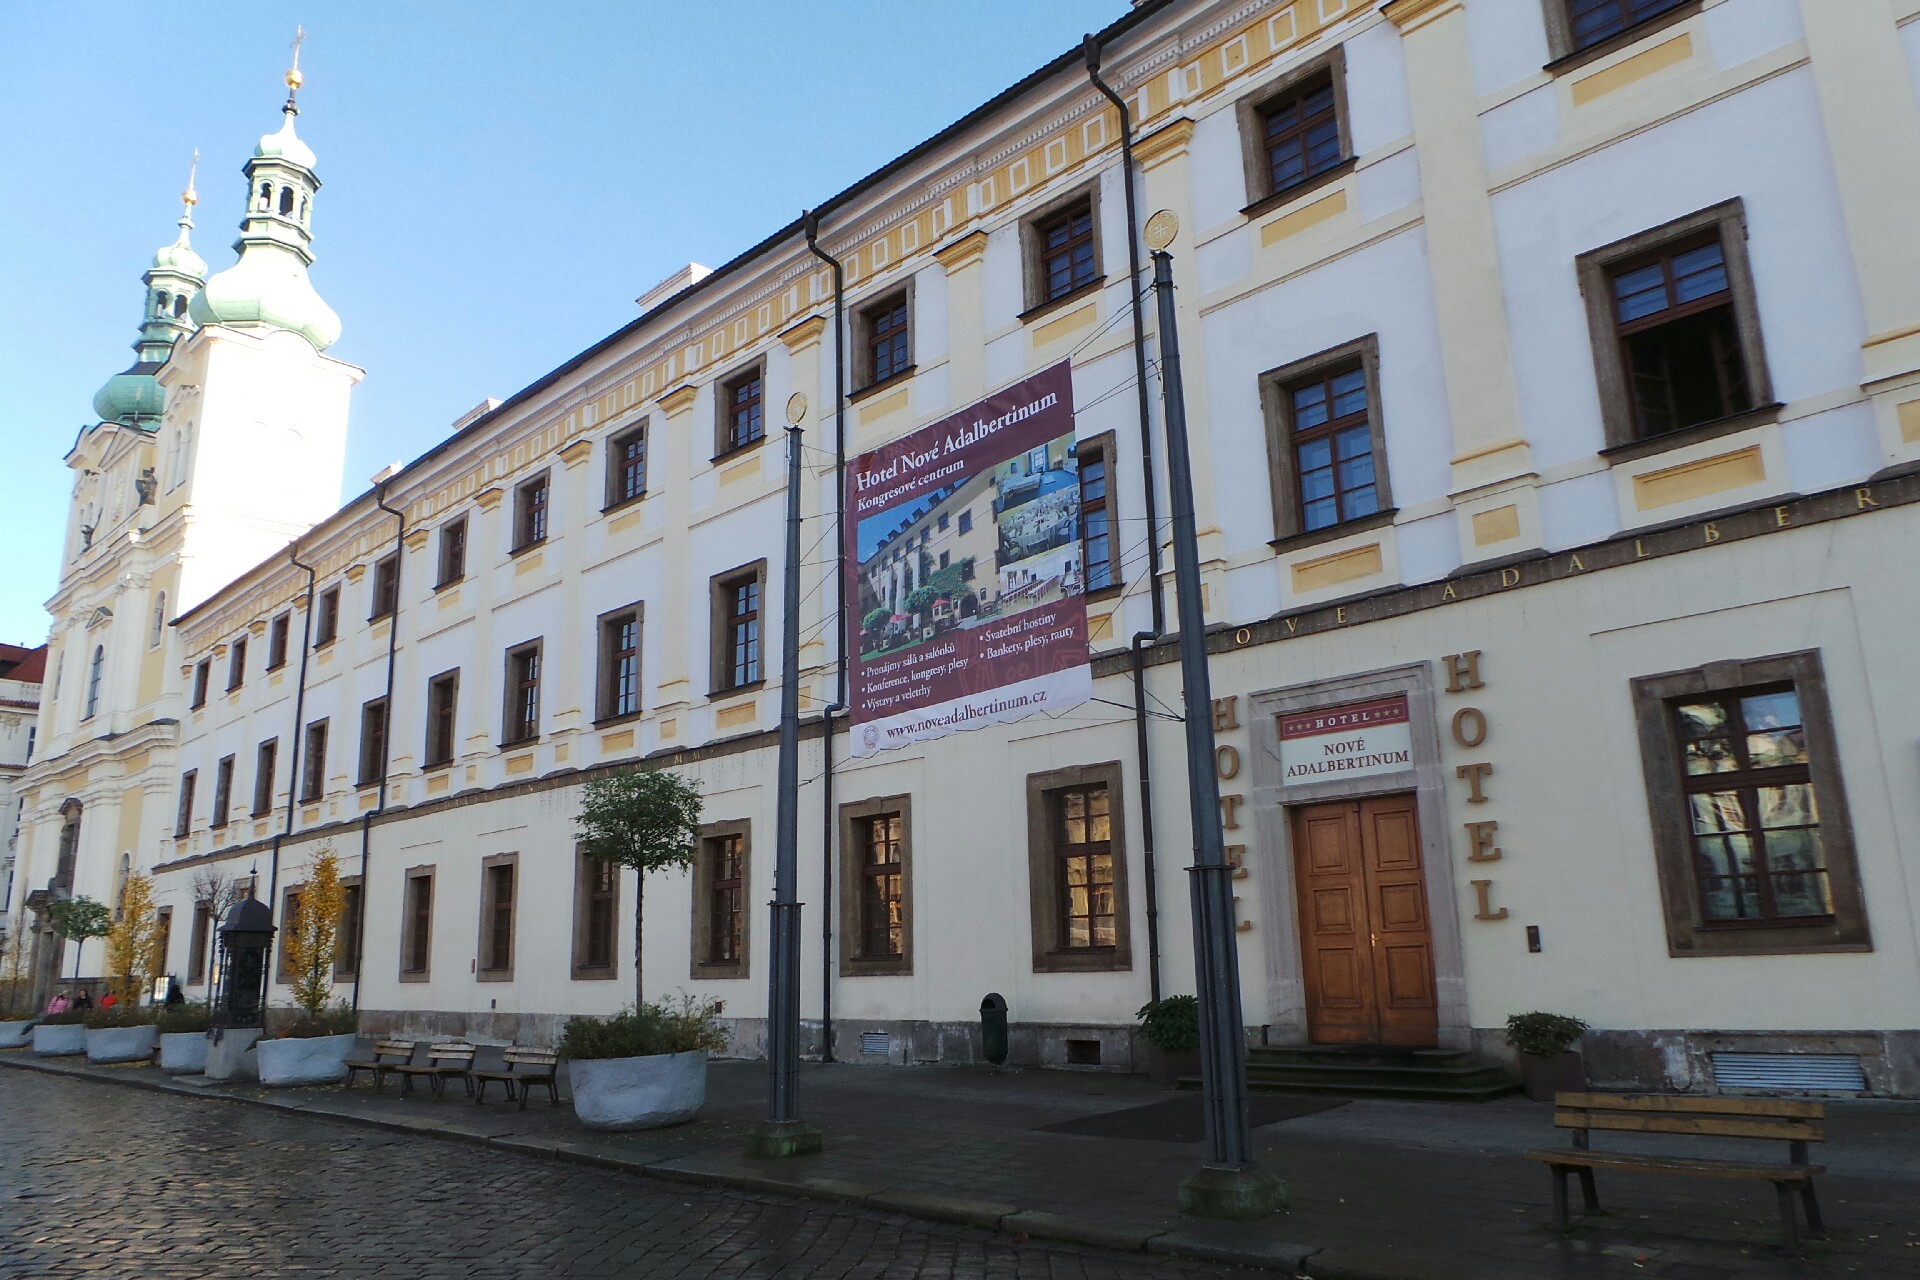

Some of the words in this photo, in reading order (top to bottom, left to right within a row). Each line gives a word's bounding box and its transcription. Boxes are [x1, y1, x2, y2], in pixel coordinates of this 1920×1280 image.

[856, 459, 898, 492] Hotel
[901, 440, 939, 475] Nové
[943, 391, 1058, 456] Adalbertinum
[858, 476, 917, 512] Kongresové
[918, 459, 965, 487] centrum
[985, 620, 1021, 642] Svatební
[1023, 613, 1056, 631] hostiny
[986, 641, 1023, 660] Bankety,
[1024, 633, 1049, 652] plesy,
[1050, 626, 1075, 641] rauty
[1235, 605, 1348, 646] OVE
[866, 661, 902, 678] Pronájmy
[902, 653, 917, 667] sálů
[925, 642, 956, 661] salónků
[867, 675, 910, 694] Konference,
[911, 663, 947, 681] kongresy,
[948, 657, 969, 674] plesy
[866, 695, 896, 712] Výstavy
[901, 683, 932, 699] veletrhy
[886, 689, 1047, 739] www.noveadalbertinum.cz
[1315, 712, 1370, 729] HOTEL
[1286, 749, 1410, 778] ADALBERTINUM
[1323, 736, 1366, 756] NOVÉ
[1441, 649, 1508, 922] HOTEL
[1211, 694, 1253, 933] HOTE
